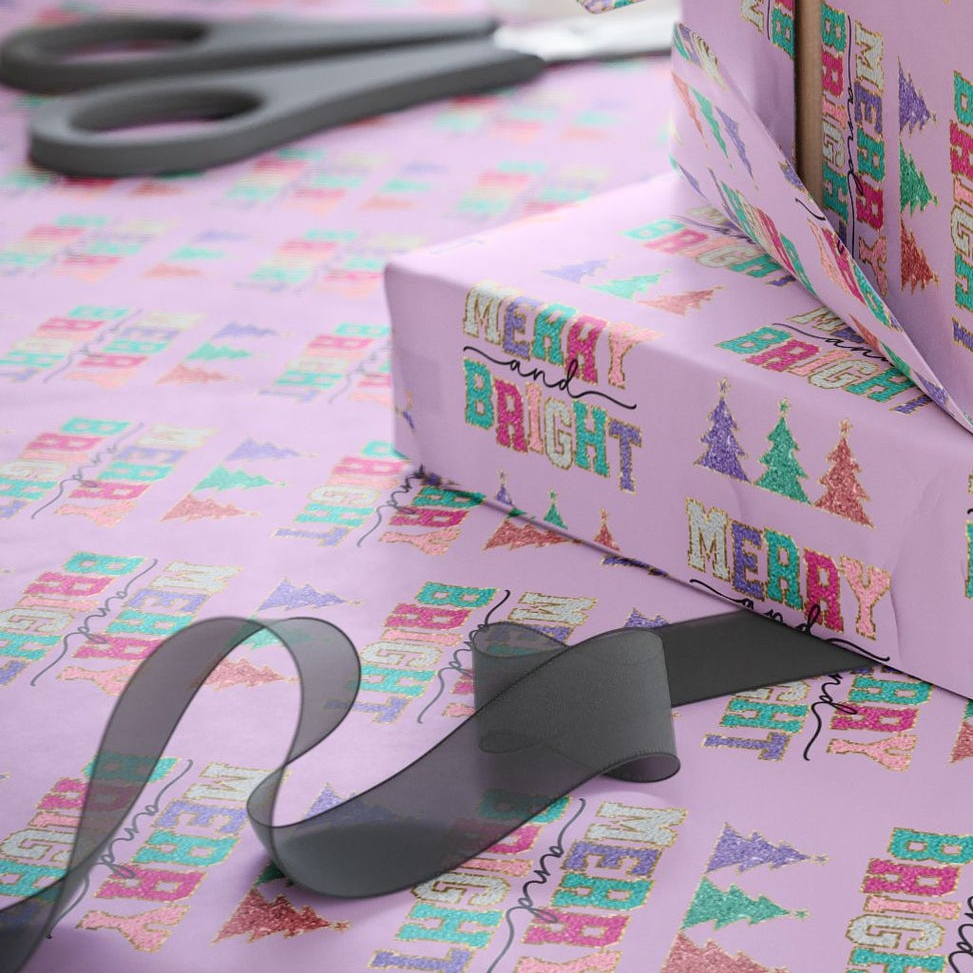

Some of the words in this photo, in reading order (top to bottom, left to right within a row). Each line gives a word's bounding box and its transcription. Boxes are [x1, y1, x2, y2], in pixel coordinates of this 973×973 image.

[820, 0, 849, 249] BRIGH
[854, 19, 888, 298] MERRY
[462, 279, 664, 391] MERRY
[462, 345, 638, 410] and
[461, 356, 643, 496] BRIGHT
[685, 496, 893, 641] MERRY
